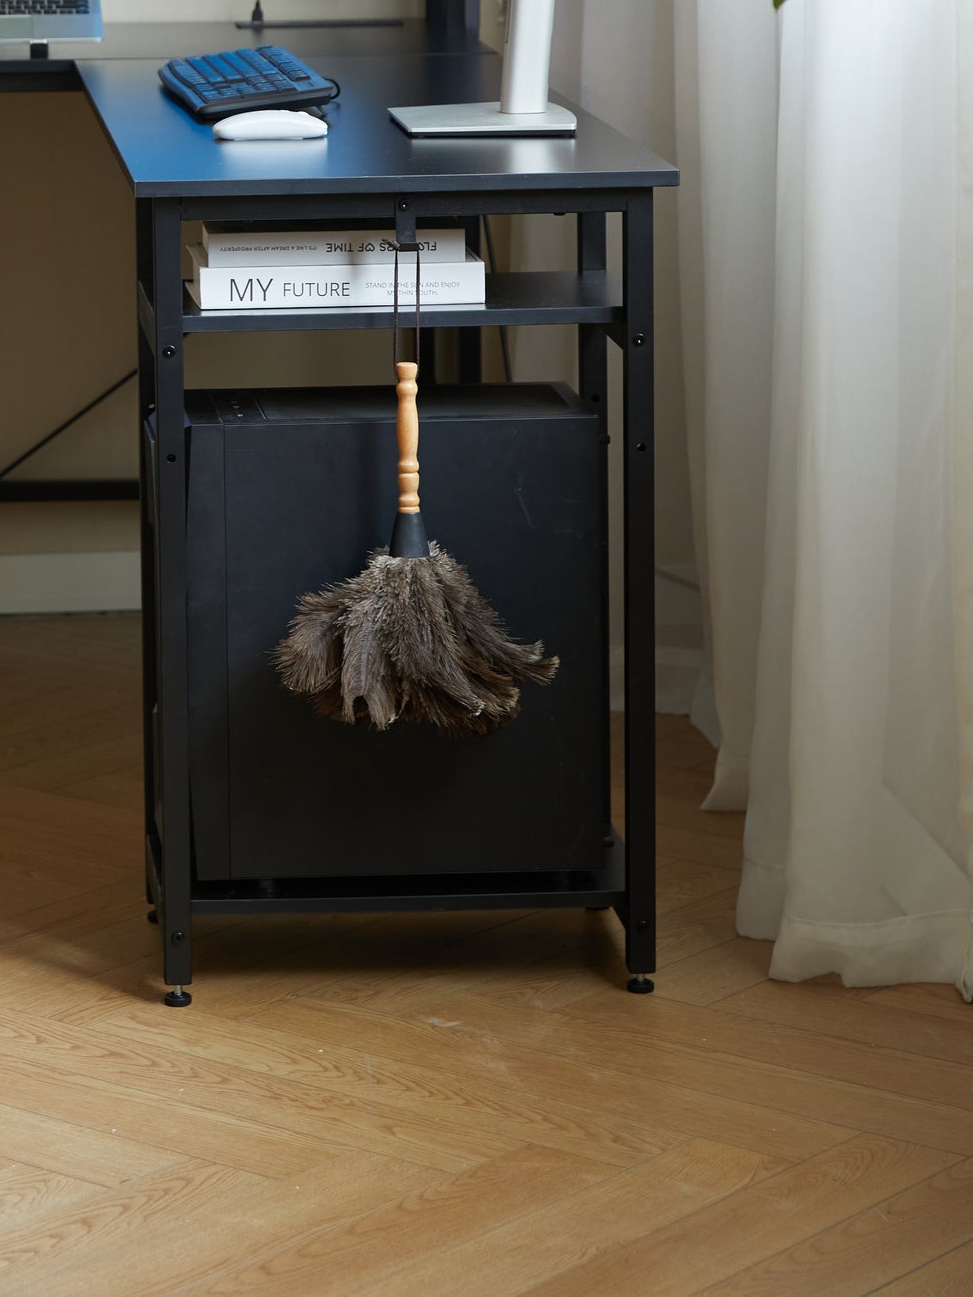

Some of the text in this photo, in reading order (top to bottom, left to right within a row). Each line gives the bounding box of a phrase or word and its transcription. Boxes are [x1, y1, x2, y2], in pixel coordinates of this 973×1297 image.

[325, 243, 353, 253] TIME
[230, 278, 351, 302] MY FUTURE
[440, 281, 460, 289] ENJOY
